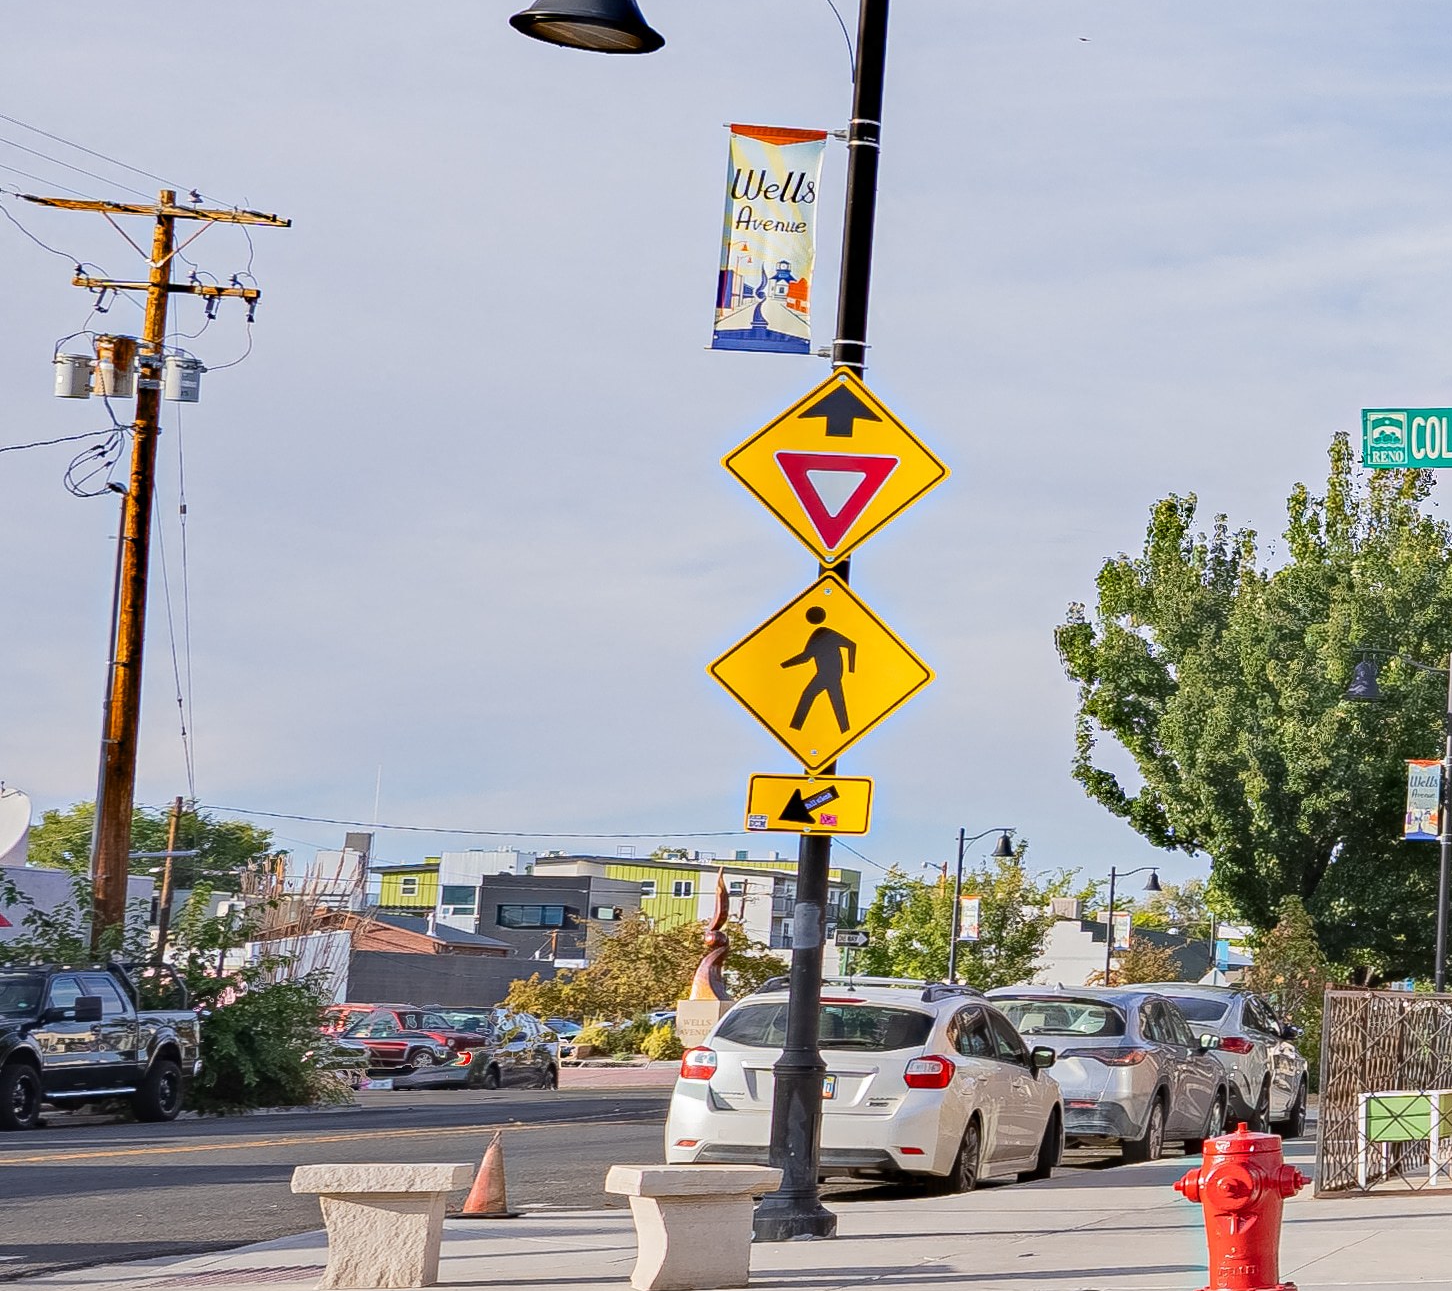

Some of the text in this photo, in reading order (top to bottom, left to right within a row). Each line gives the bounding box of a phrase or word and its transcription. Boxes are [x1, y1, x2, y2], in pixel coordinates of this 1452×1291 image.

[730, 167, 816, 205] Wells
[735, 205, 808, 235] Avenue
[1371, 451, 1404, 463] RENO
[1410, 775, 1438, 788] Wells
